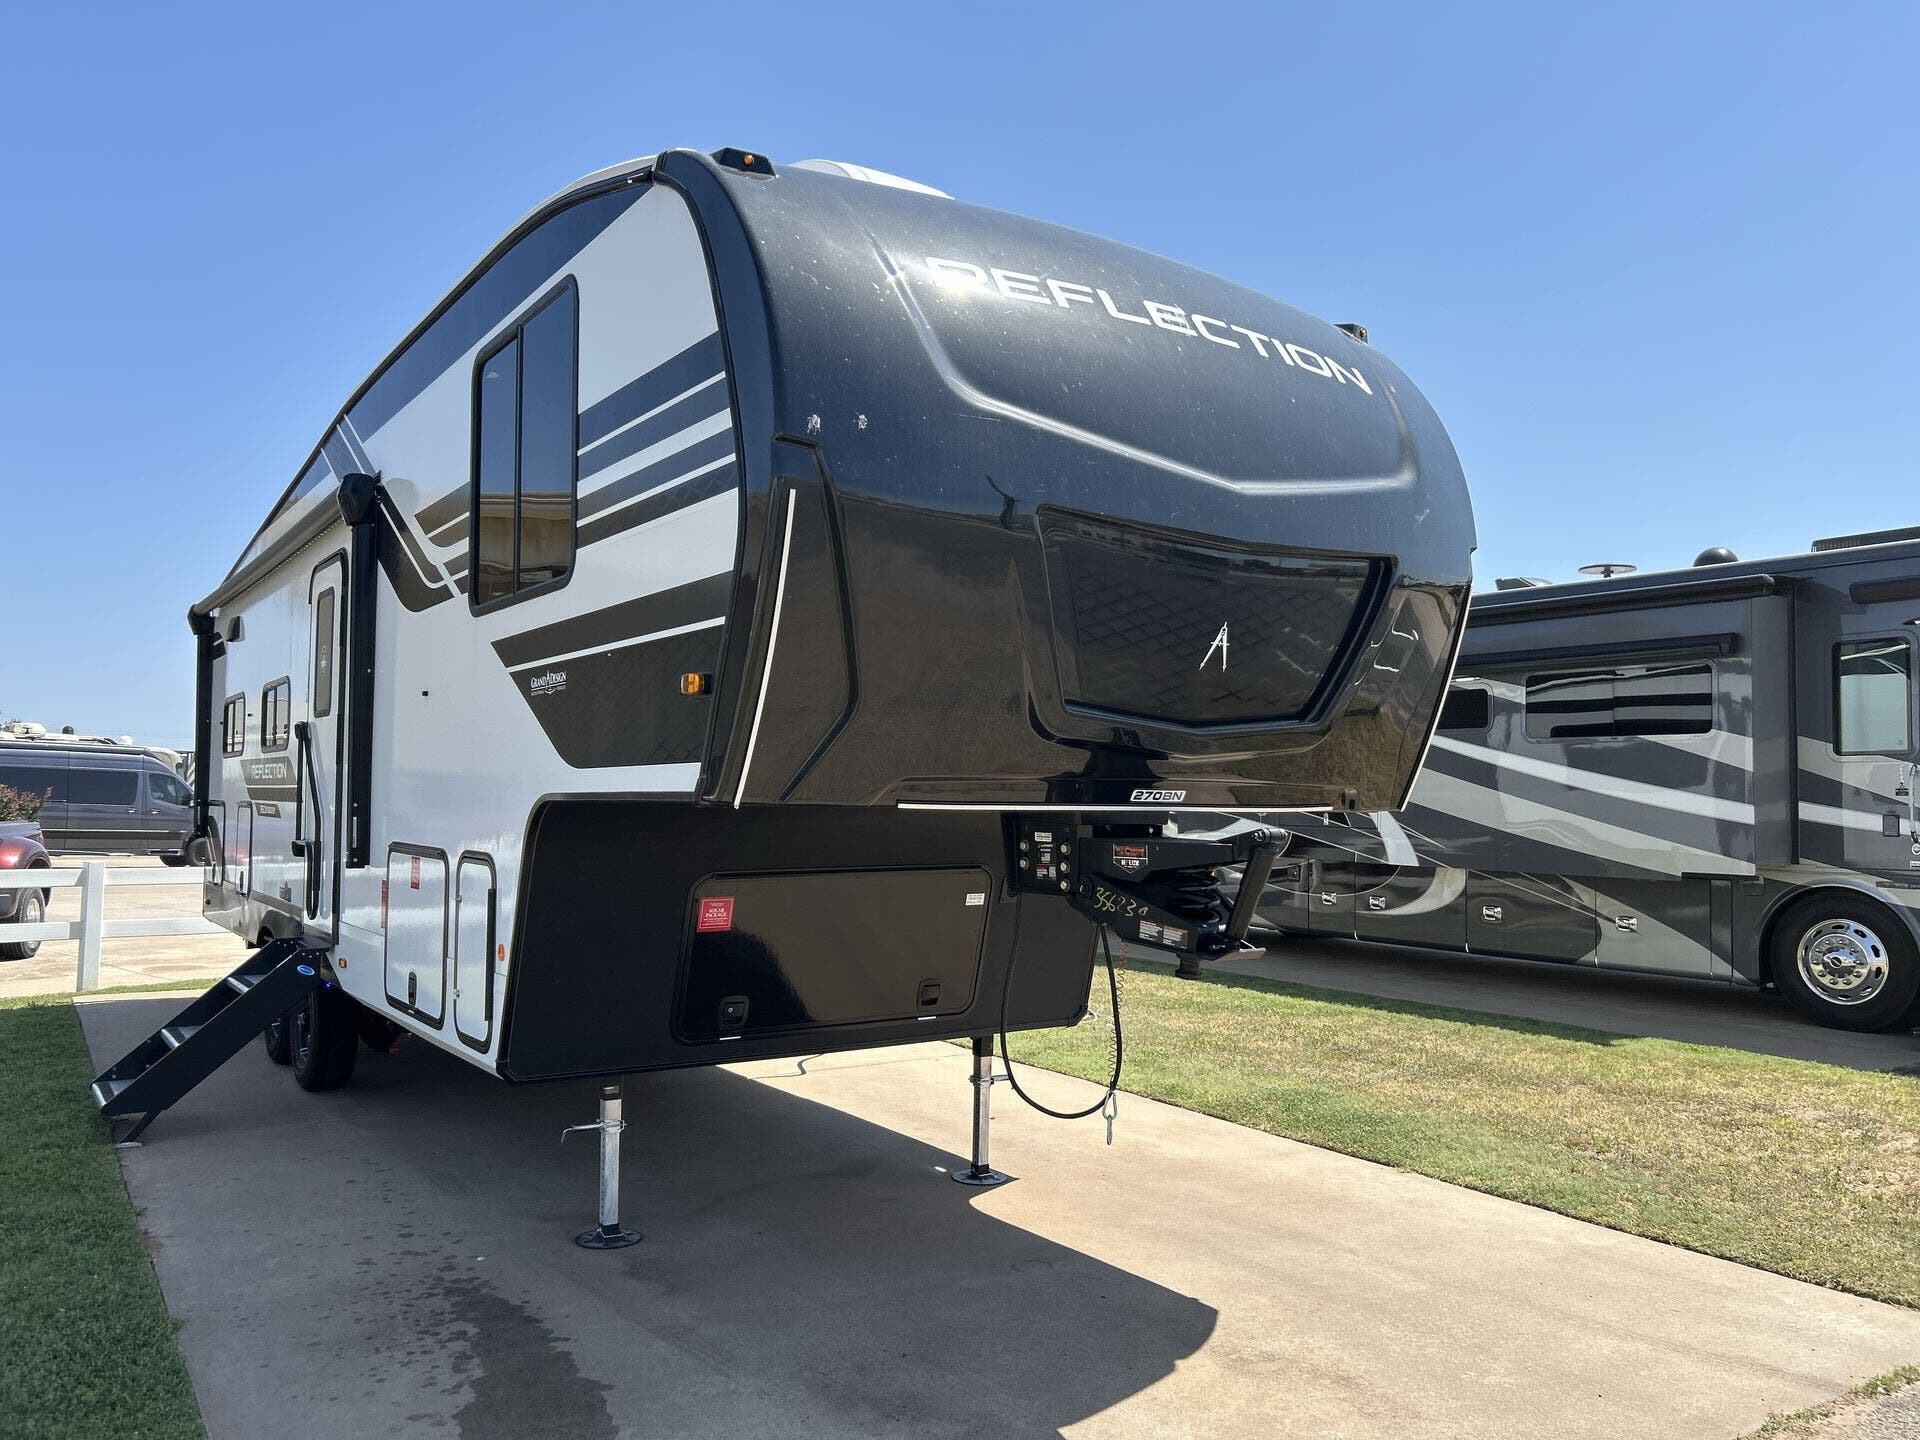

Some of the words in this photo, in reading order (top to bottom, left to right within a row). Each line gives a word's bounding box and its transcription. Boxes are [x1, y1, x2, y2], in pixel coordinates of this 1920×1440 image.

[925, 256, 1373, 395] REFLECTION
[251, 762, 287, 779] REFLECTION
[1133, 791, 1183, 800] 270BN
